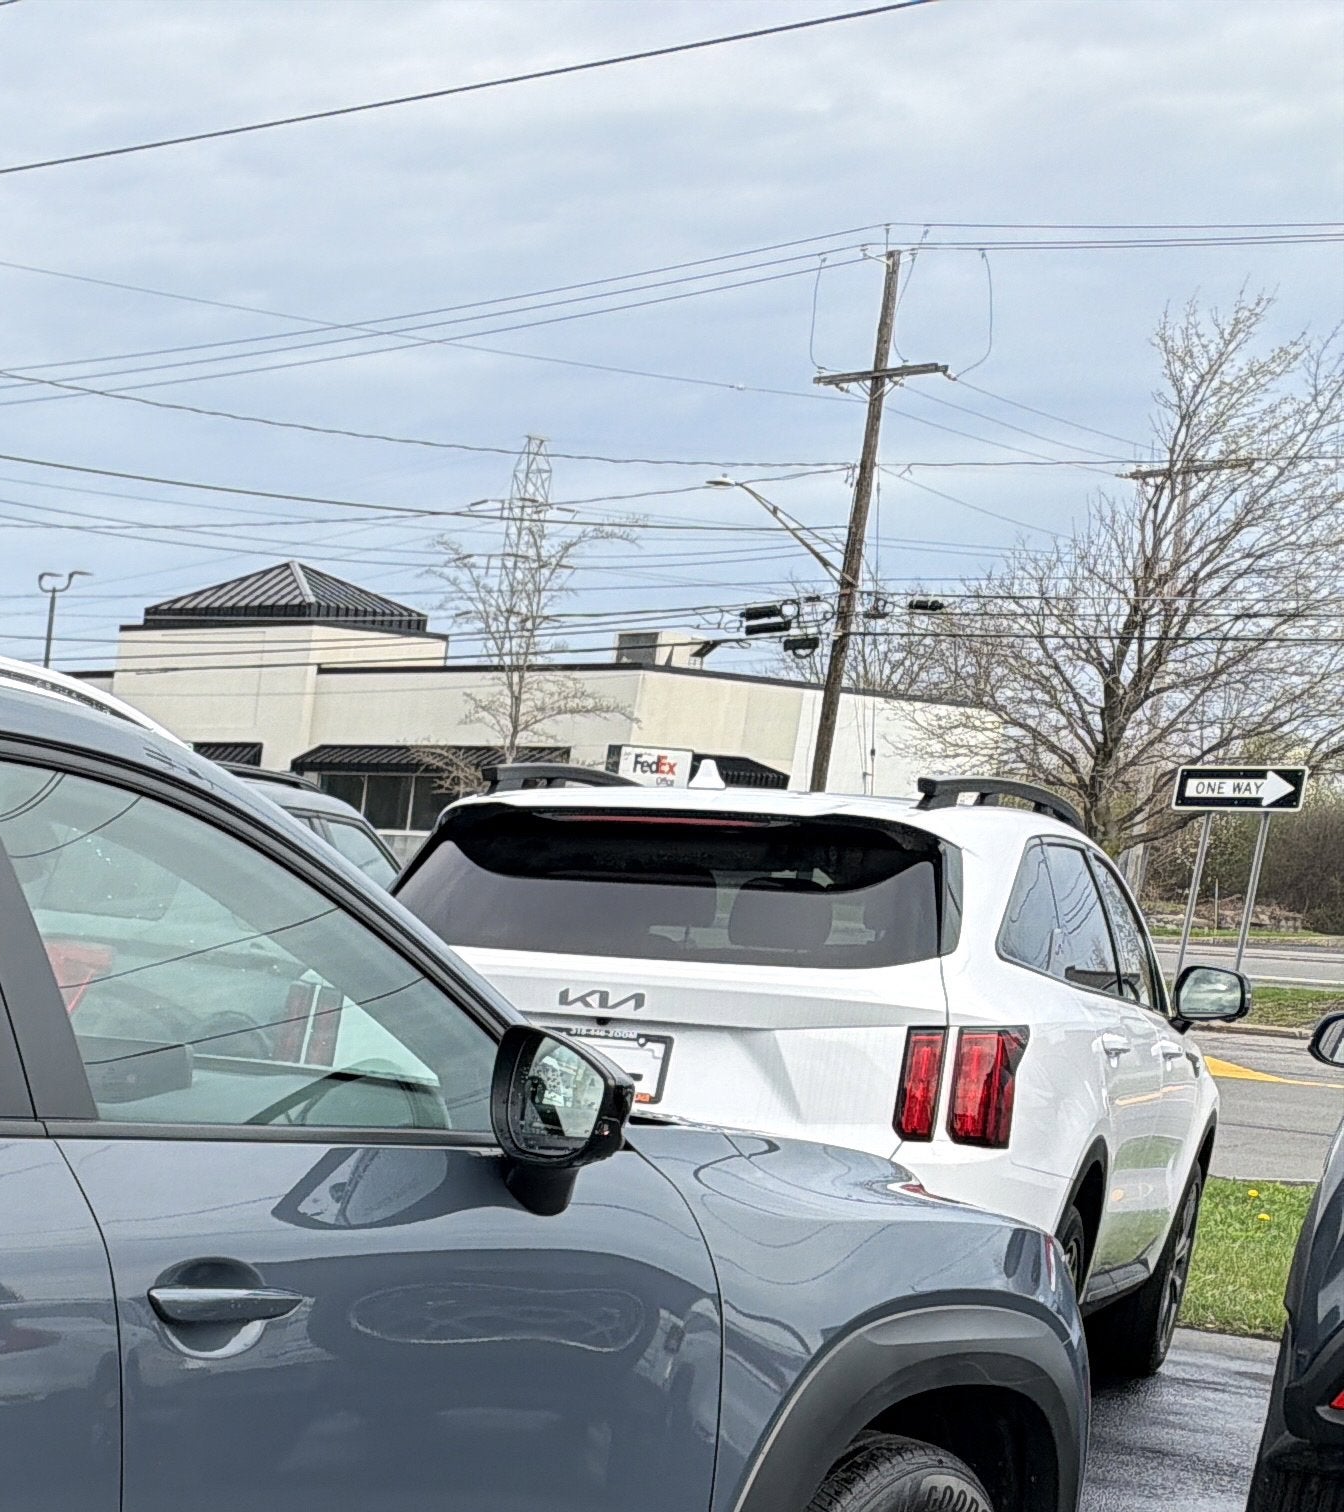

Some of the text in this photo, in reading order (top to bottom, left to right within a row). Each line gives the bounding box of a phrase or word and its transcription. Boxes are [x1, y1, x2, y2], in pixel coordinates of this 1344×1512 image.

[632, 753, 678, 776] FedEx
[1195, 781, 1264, 795] ONE WAY
[558, 987, 646, 1011] KIA
